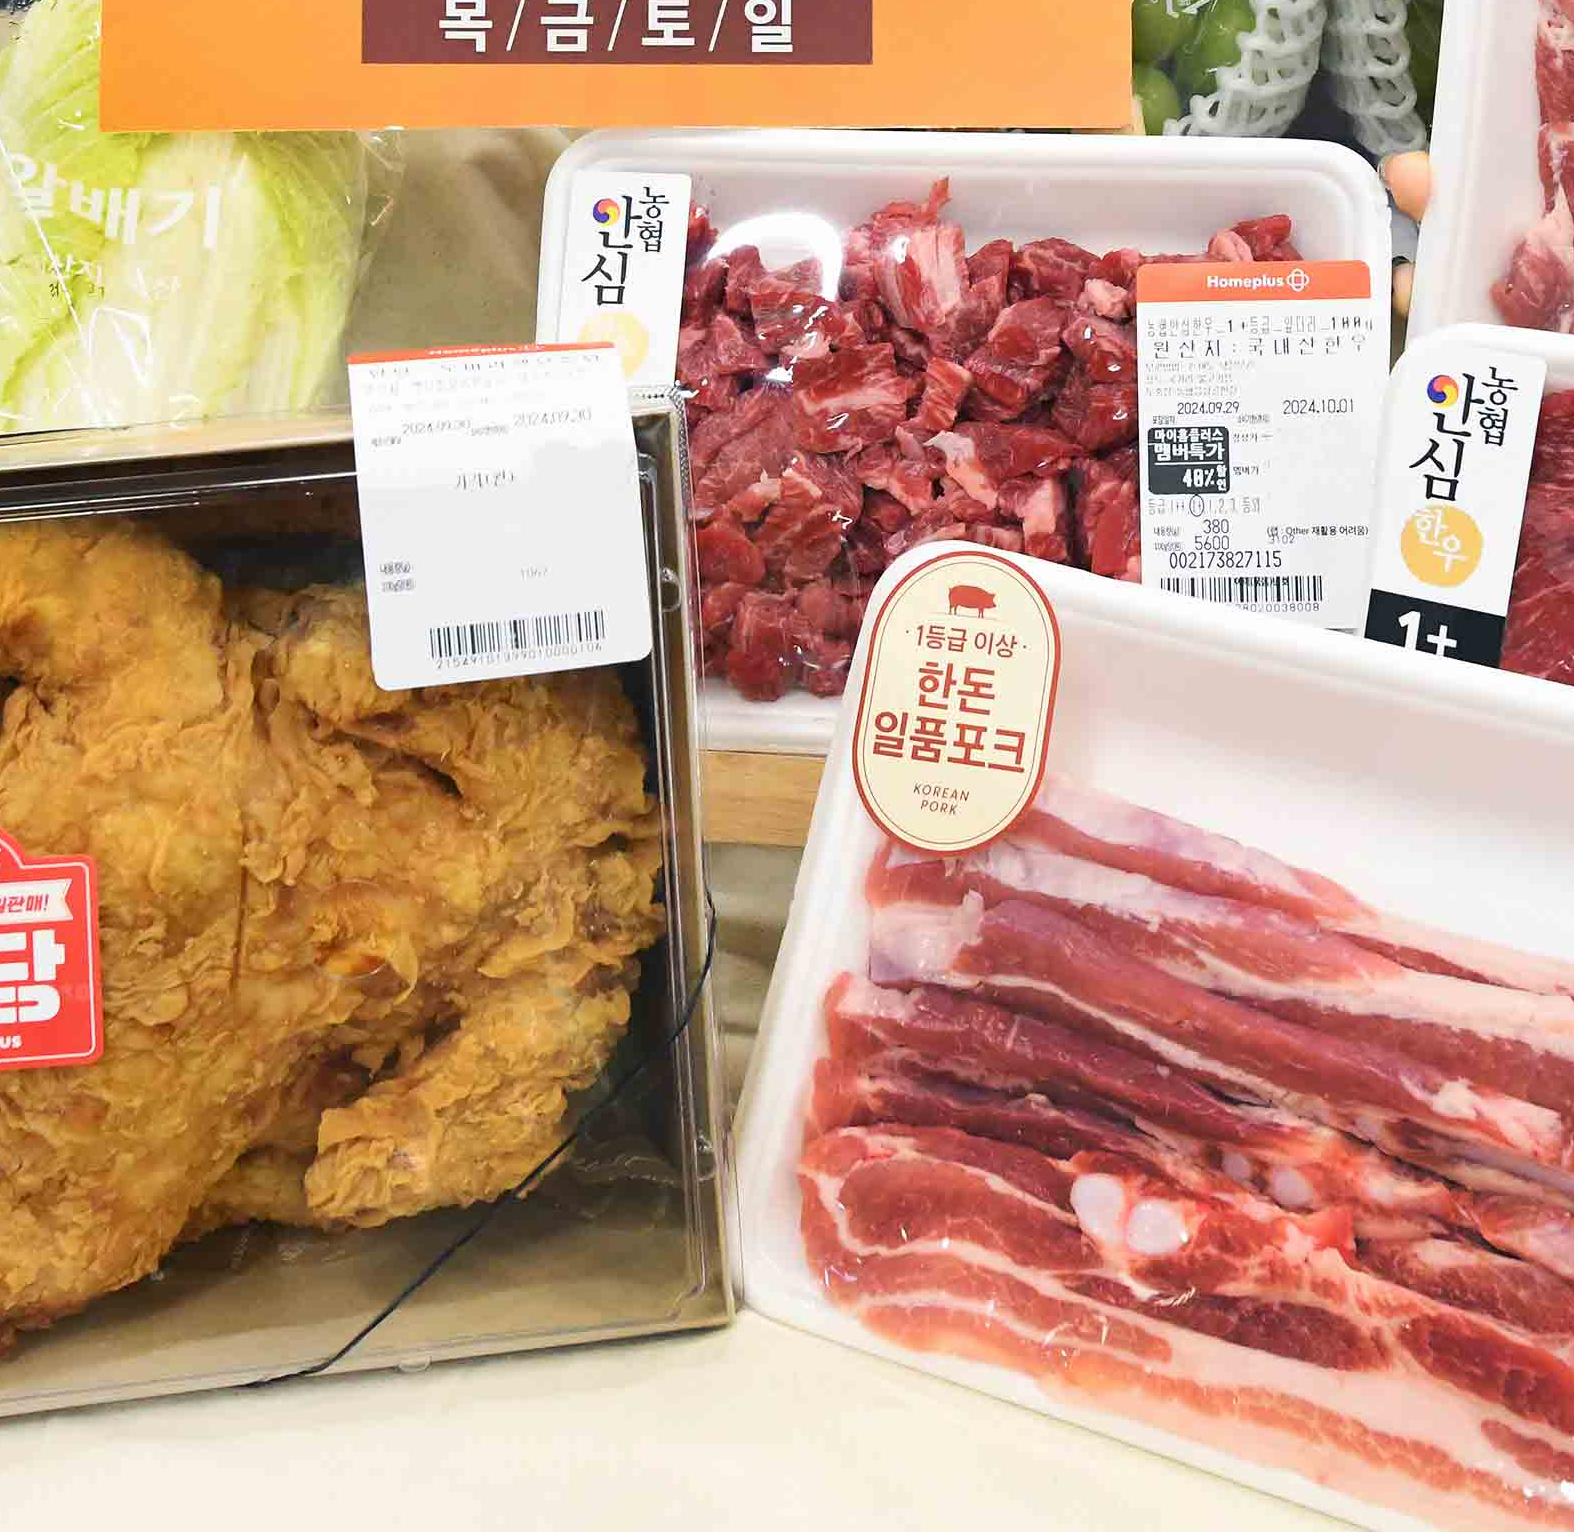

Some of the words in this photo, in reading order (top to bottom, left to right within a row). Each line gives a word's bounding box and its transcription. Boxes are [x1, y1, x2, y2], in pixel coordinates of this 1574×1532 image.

[7, 152, 221, 251] 알배기
[637, 185, 671, 253] 농협
[1206, 274, 1285, 290] Homeplus
[1177, 400, 1241, 416] 2024.09.29
[1282, 398, 1355, 416] 2024.10.01
[1477, 365, 1519, 447] 농협
[1153, 428, 1224, 443] 마이홈플러스
[1408, 371, 1486, 502] 안심
[1153, 442, 1226, 462] 멤버특가
[1182, 467, 1216, 488] 40%
[1202, 518, 1230, 535] 380
[1311, 524, 1338, 537] 재활용
[1338, 525, 1370, 538] 어려움)
[1193, 535, 1231, 552] 5600
[1168, 550, 1283, 570] 002173827115
[916, 623, 969, 654] 1등급
[973, 630, 1019, 659] 이상
[1398, 609, 1458, 658] 1+
[917, 660, 996, 717] 한돈
[872, 710, 1027, 774] 일품포크
[912, 782, 970, 803] KOREAN
[920, 798, 958, 816] PORK
